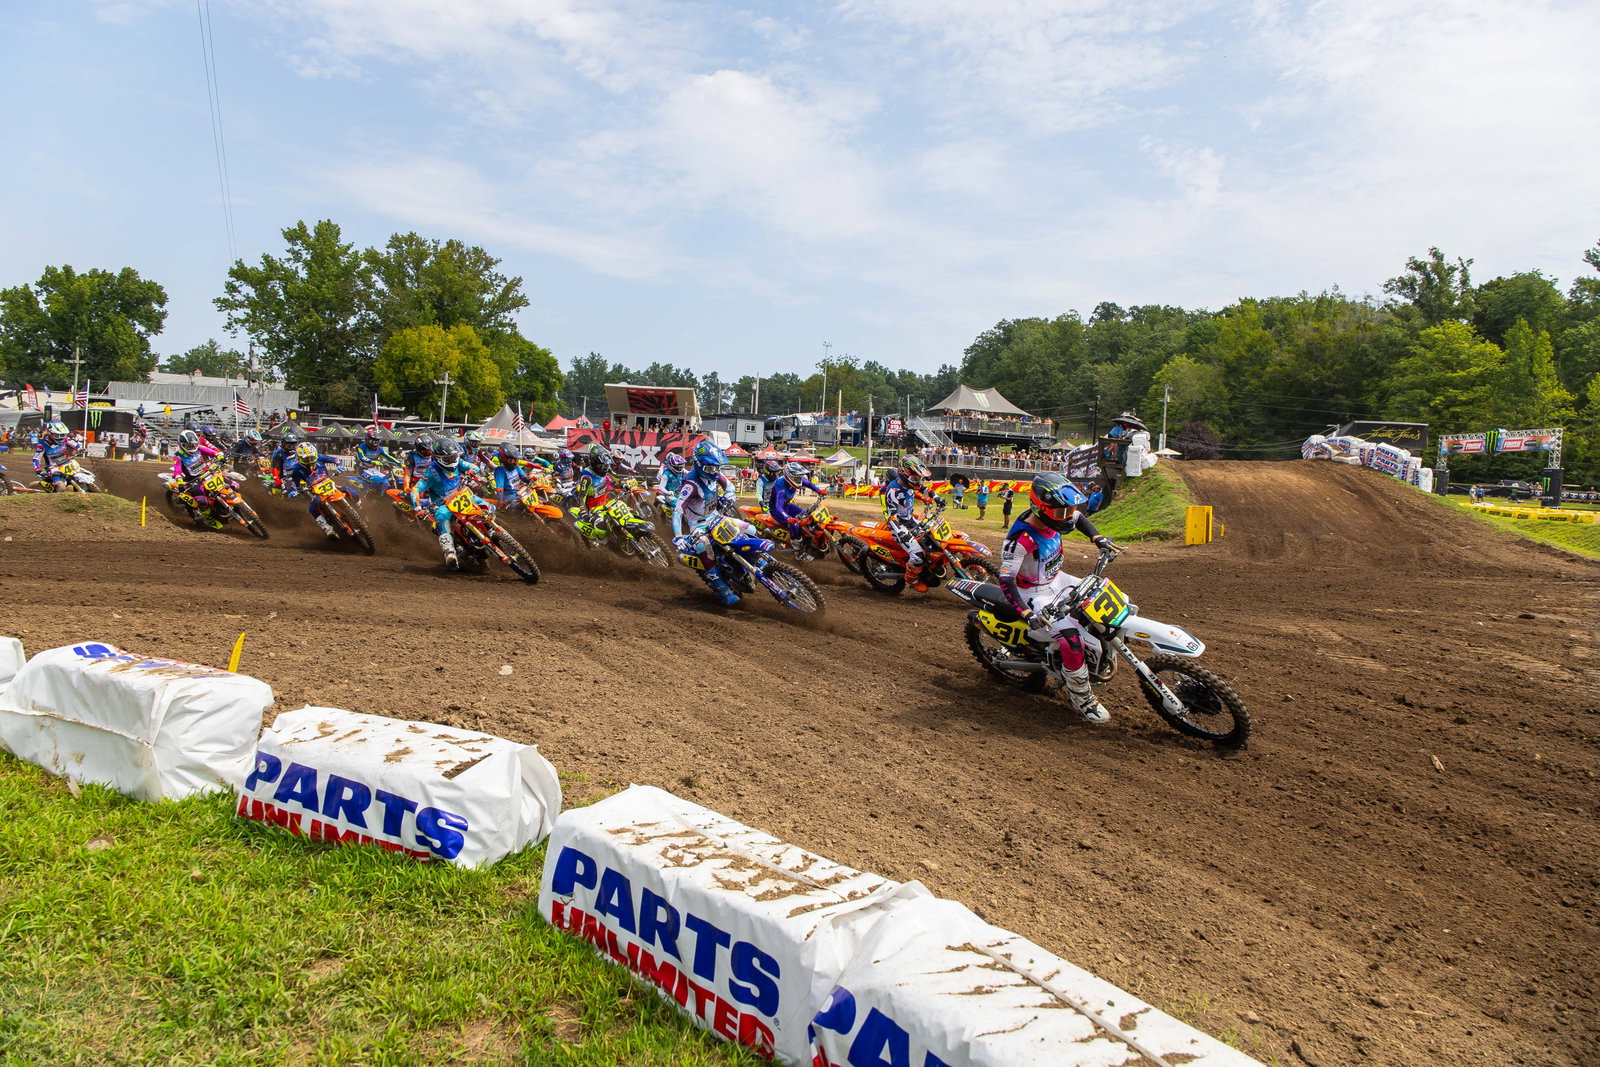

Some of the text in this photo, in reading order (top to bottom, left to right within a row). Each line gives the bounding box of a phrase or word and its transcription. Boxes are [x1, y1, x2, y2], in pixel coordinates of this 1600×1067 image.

[1376, 447, 1399, 459] PARTS
[1376, 456, 1399, 469] PARTS
[207, 476, 223, 490] 94
[318, 482, 333, 493] 33
[453, 495, 471, 512] 23
[613, 503, 629, 517] 58
[815, 508, 829, 521] 27
[581, 525, 593, 537] 58
[719, 520, 739, 543] 11
[937, 523, 950, 540] 15
[875, 546, 887, 556] 15
[688, 556, 698, 568] 11
[1094, 584, 1126, 625] 31
[993, 623, 1020, 645] 31
[245, 750, 469, 860] PARTS
[551, 845, 780, 1018] PARTS
[807, 984, 953, 1067] PA
